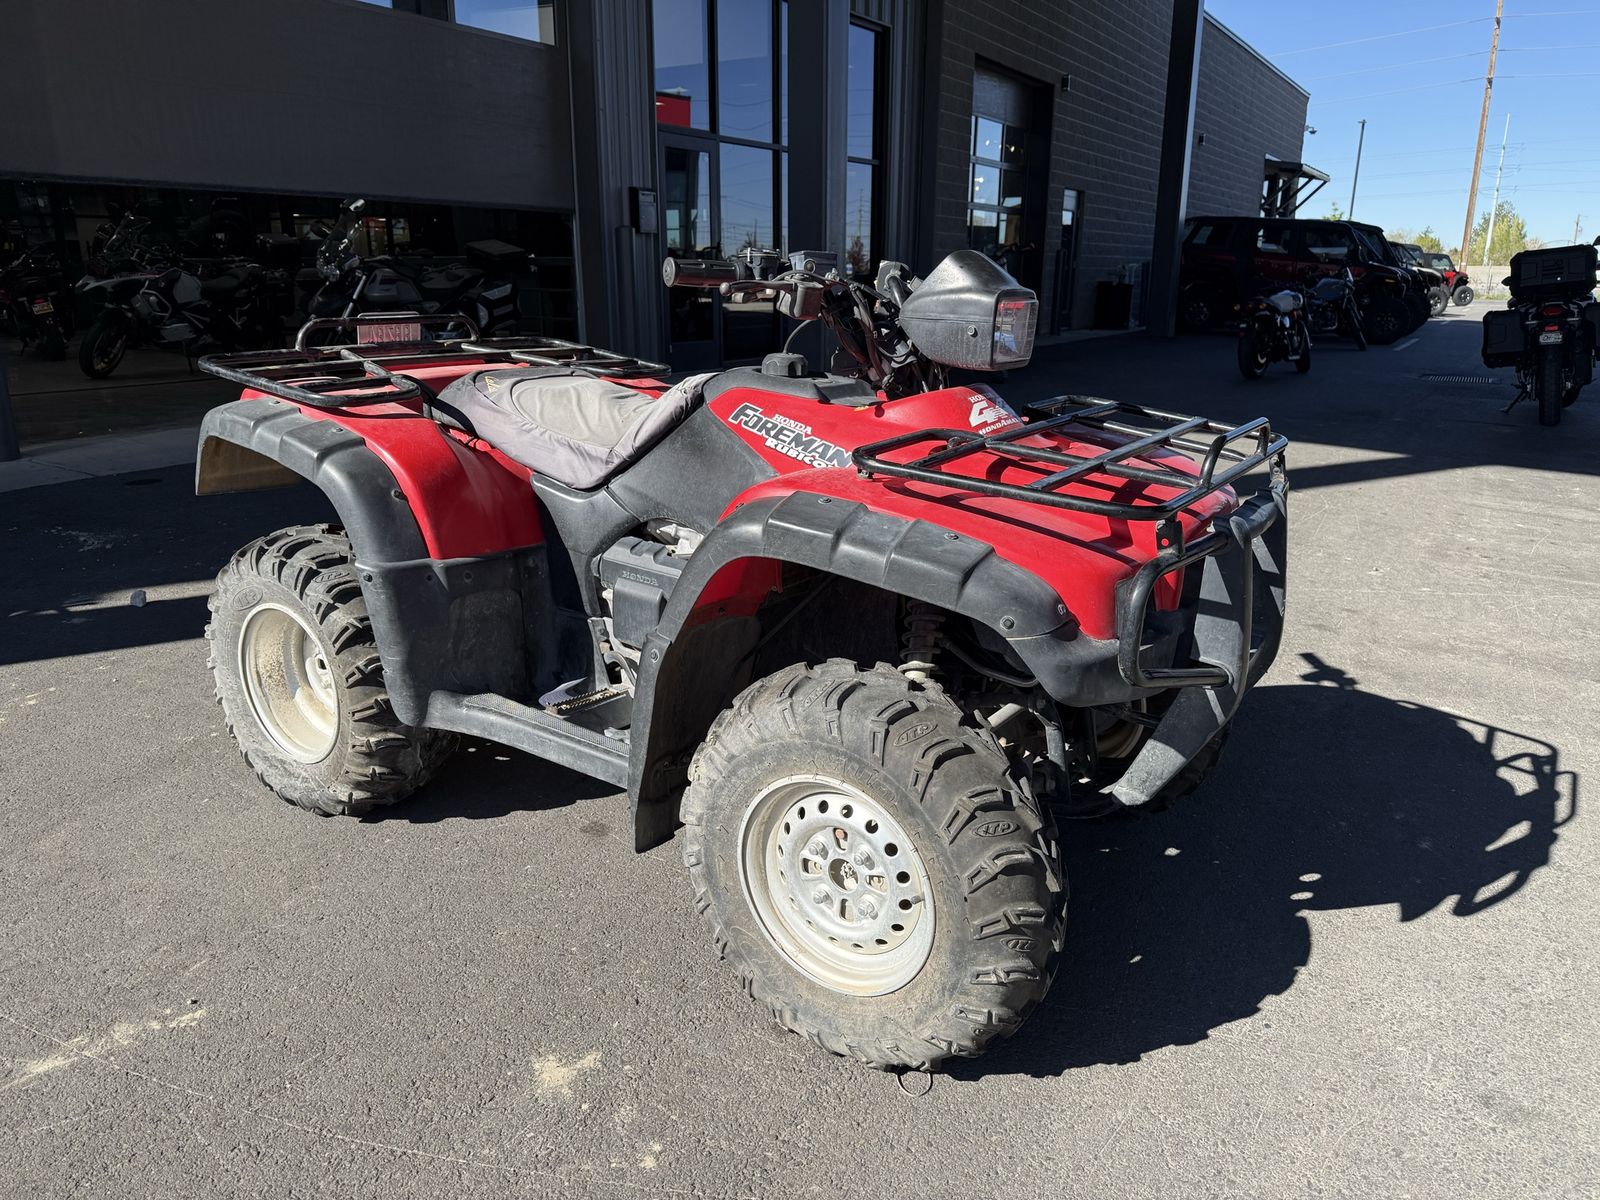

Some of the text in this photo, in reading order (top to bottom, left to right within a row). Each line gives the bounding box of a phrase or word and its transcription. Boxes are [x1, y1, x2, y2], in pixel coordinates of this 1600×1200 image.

[728, 402, 853, 467] FOREMAN
[772, 413, 812, 435] HONDA
[765, 438, 834, 469] RUBICO
[622, 570, 659, 586] HONDA
